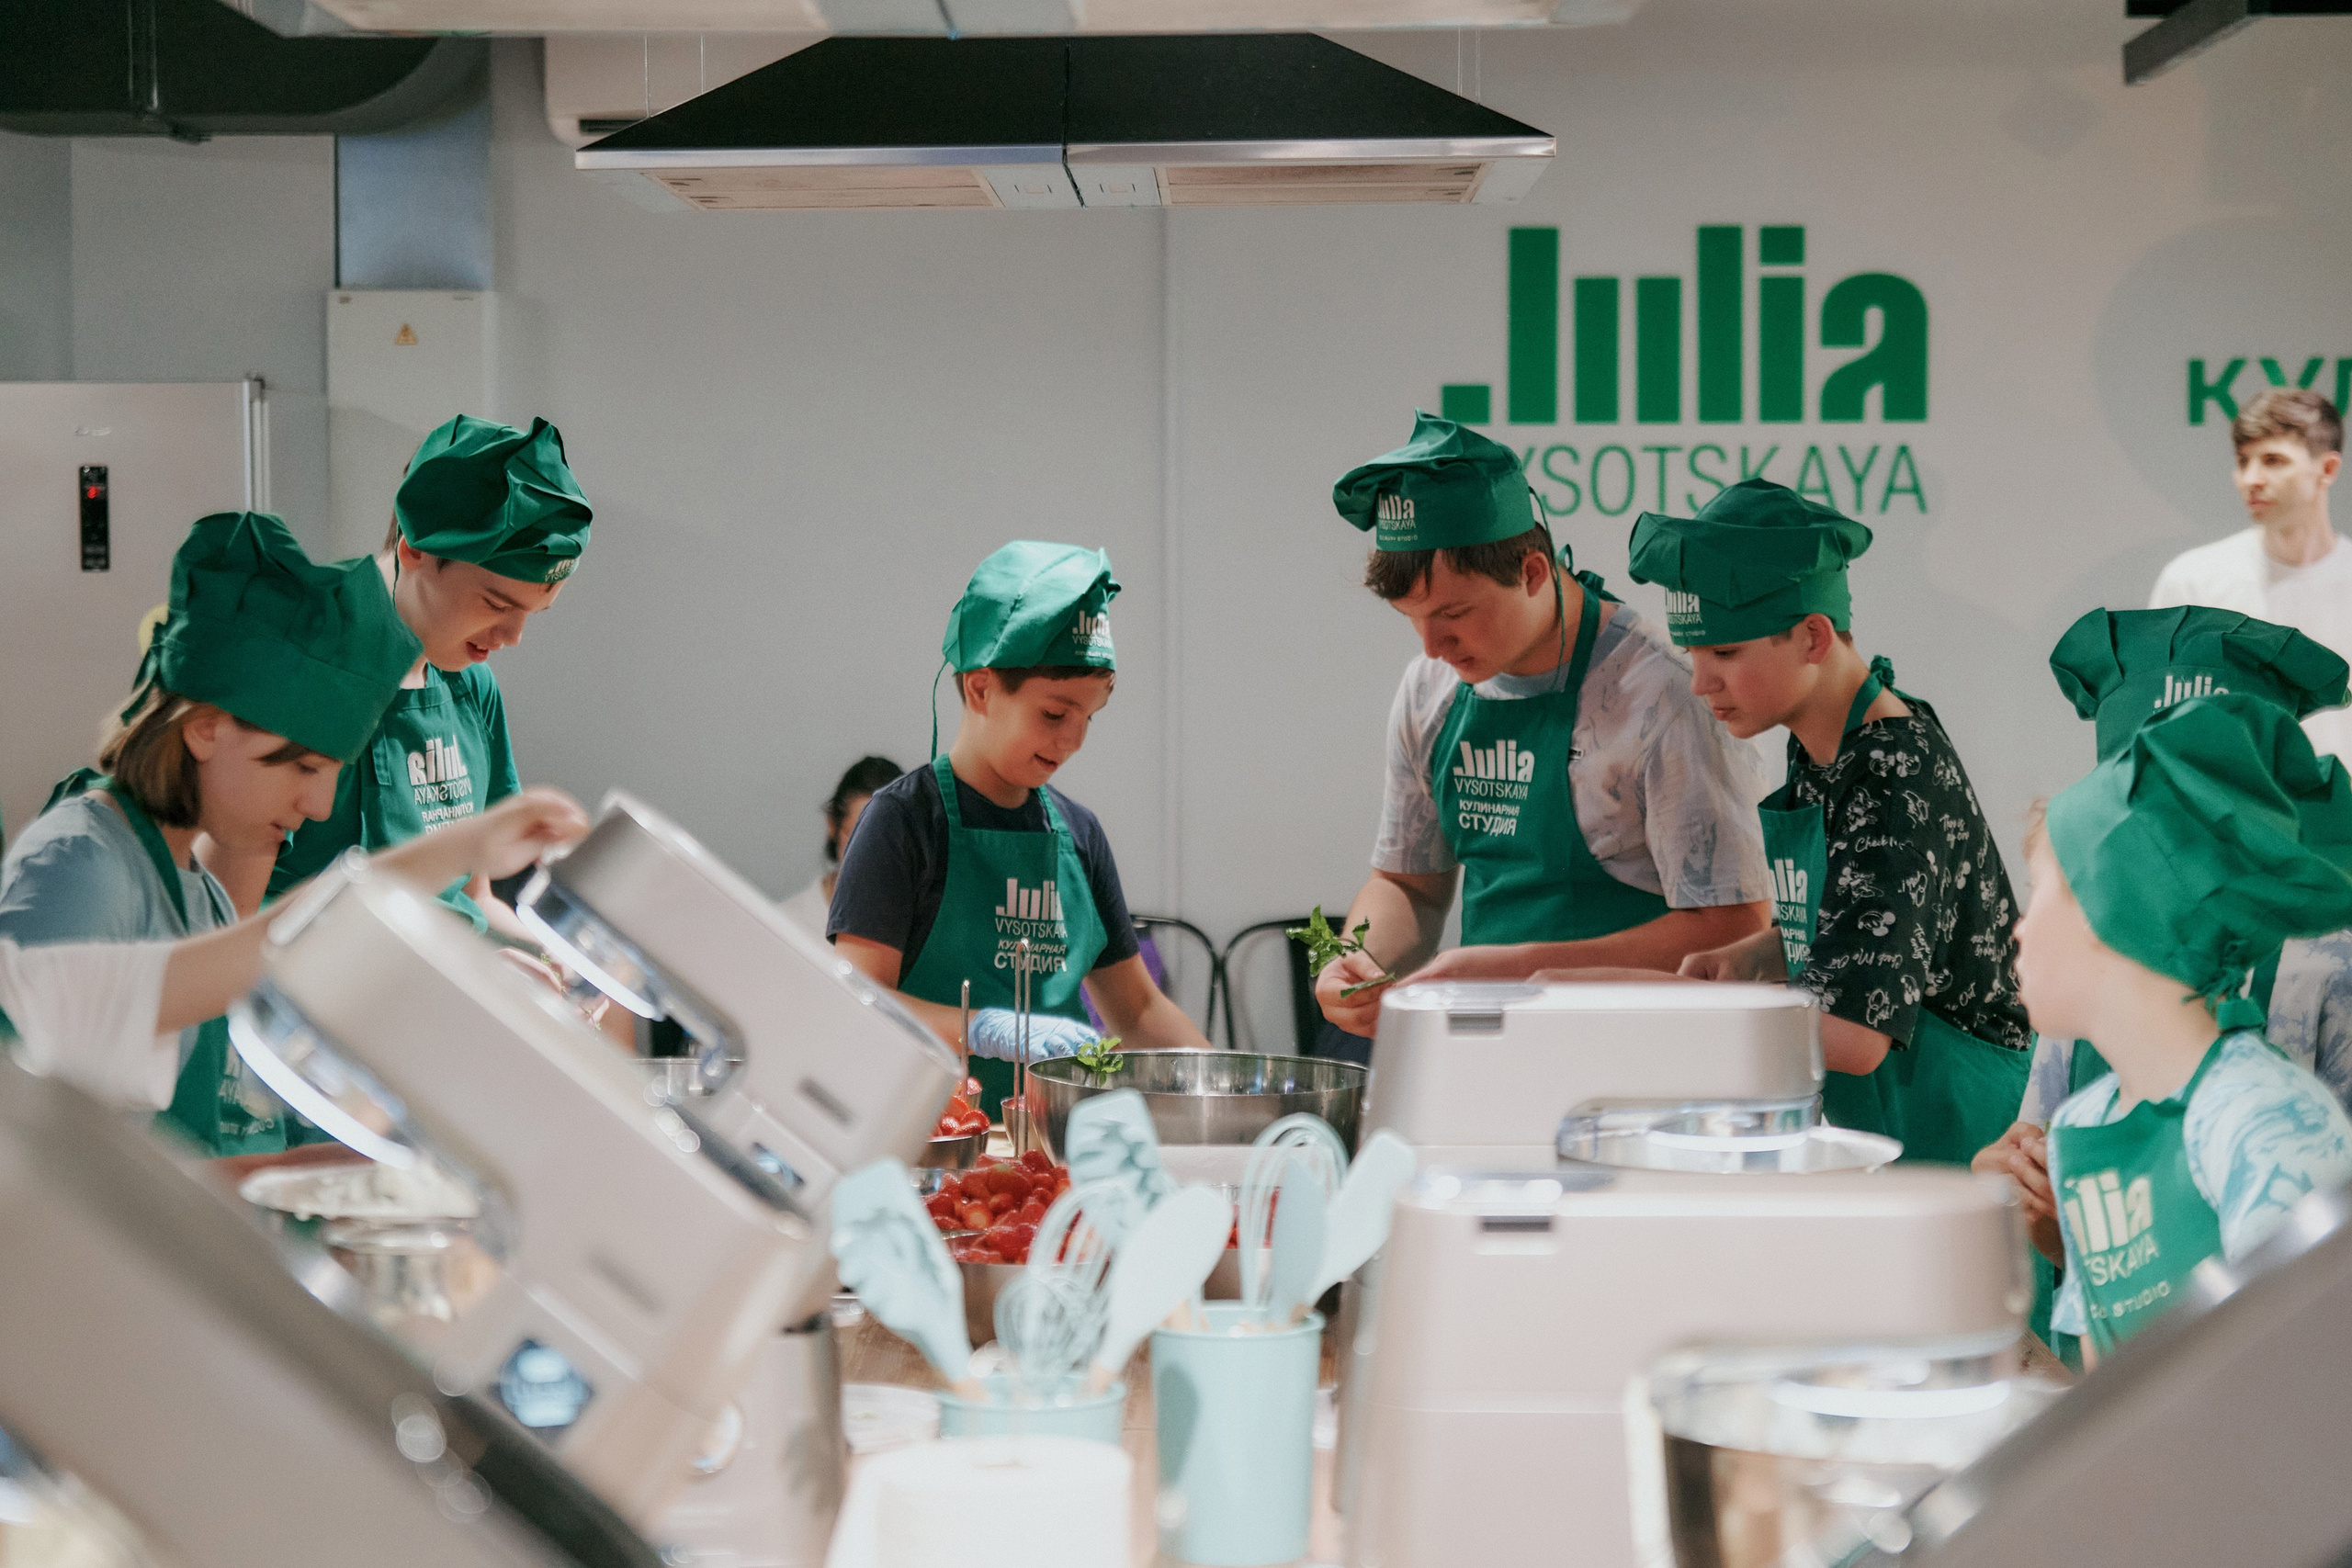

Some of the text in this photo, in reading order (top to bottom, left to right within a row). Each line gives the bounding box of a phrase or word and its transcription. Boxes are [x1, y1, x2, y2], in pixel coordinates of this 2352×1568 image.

[1442, 225, 1928, 424] Julia
[1521, 444, 1928, 516] SOTSKAYA
[1453, 739, 1534, 783] Julia
[1454, 778, 1528, 800] VYSOTSKAYA
[1459, 799, 1521, 817] КУЛИНАРНАЯ
[1459, 812, 1517, 837] СТУДИЯ
